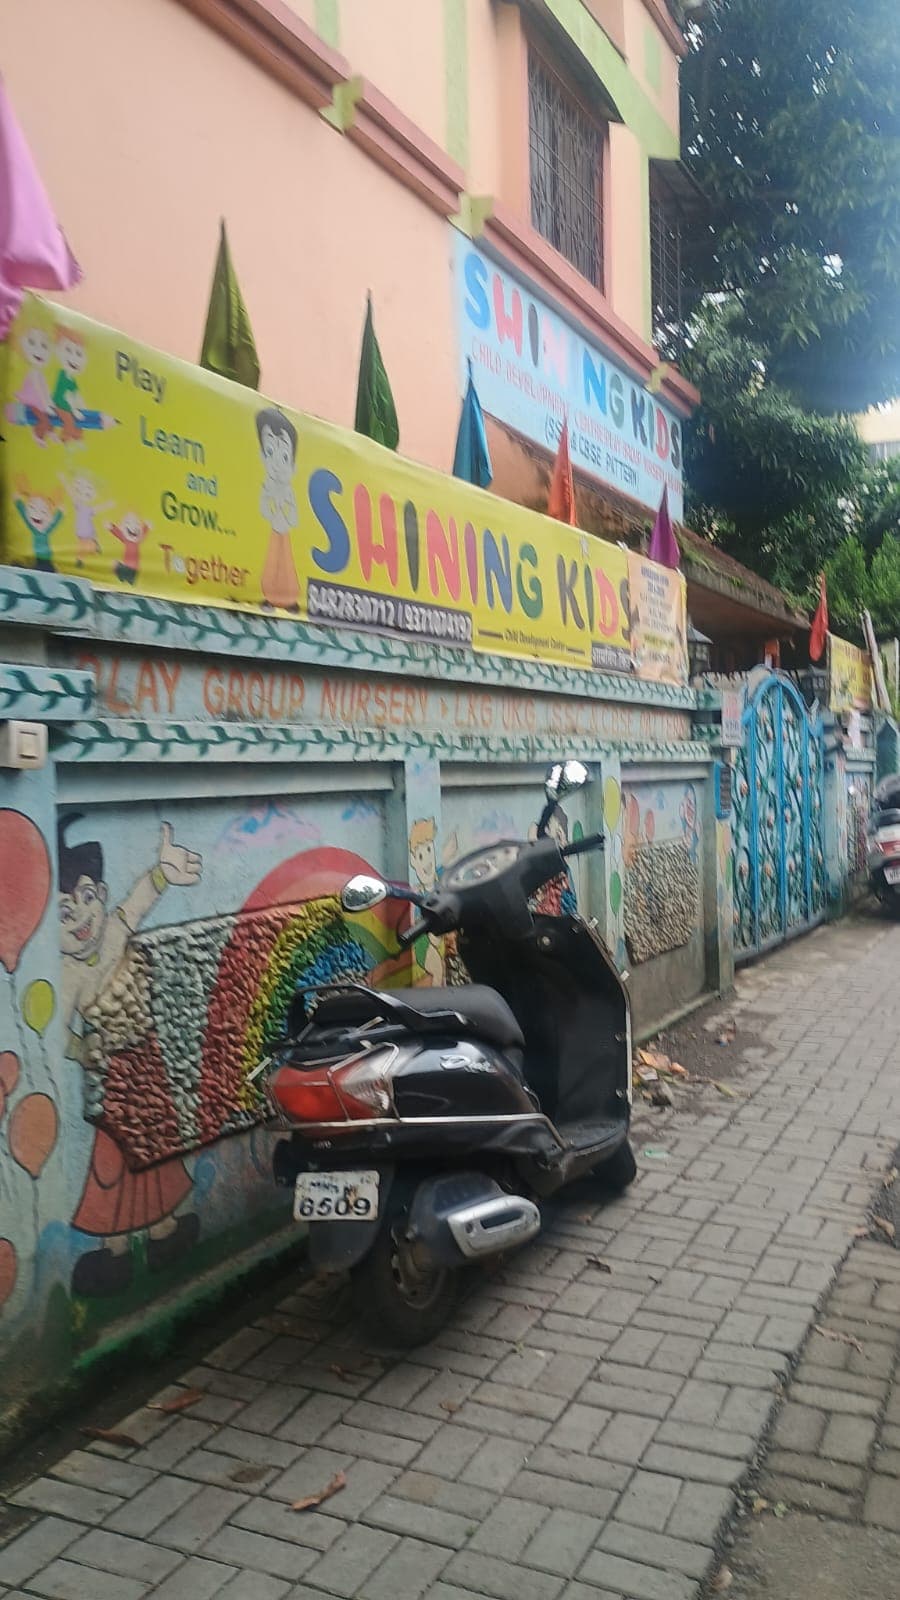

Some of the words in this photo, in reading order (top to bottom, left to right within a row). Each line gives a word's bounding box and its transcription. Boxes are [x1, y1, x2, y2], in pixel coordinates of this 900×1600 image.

[115, 351, 167, 404] Play
[465, 254, 624, 430] SHINNG
[630, 389, 681, 470] KIDS
[140, 416, 205, 465] Learn
[579, 433, 602, 467] CBSE
[186, 471, 219, 497] and
[161, 492, 236, 536] Grow...
[159, 544, 250, 587] Together
[308, 468, 543, 619] SHINING
[203, 665, 305, 721] GROUP
[320, 677, 429, 728] NURSERY
[454, 688, 493, 728] LKG
[502, 694, 536, 732] UKG
[300, 1196, 371, 1216] 6509
